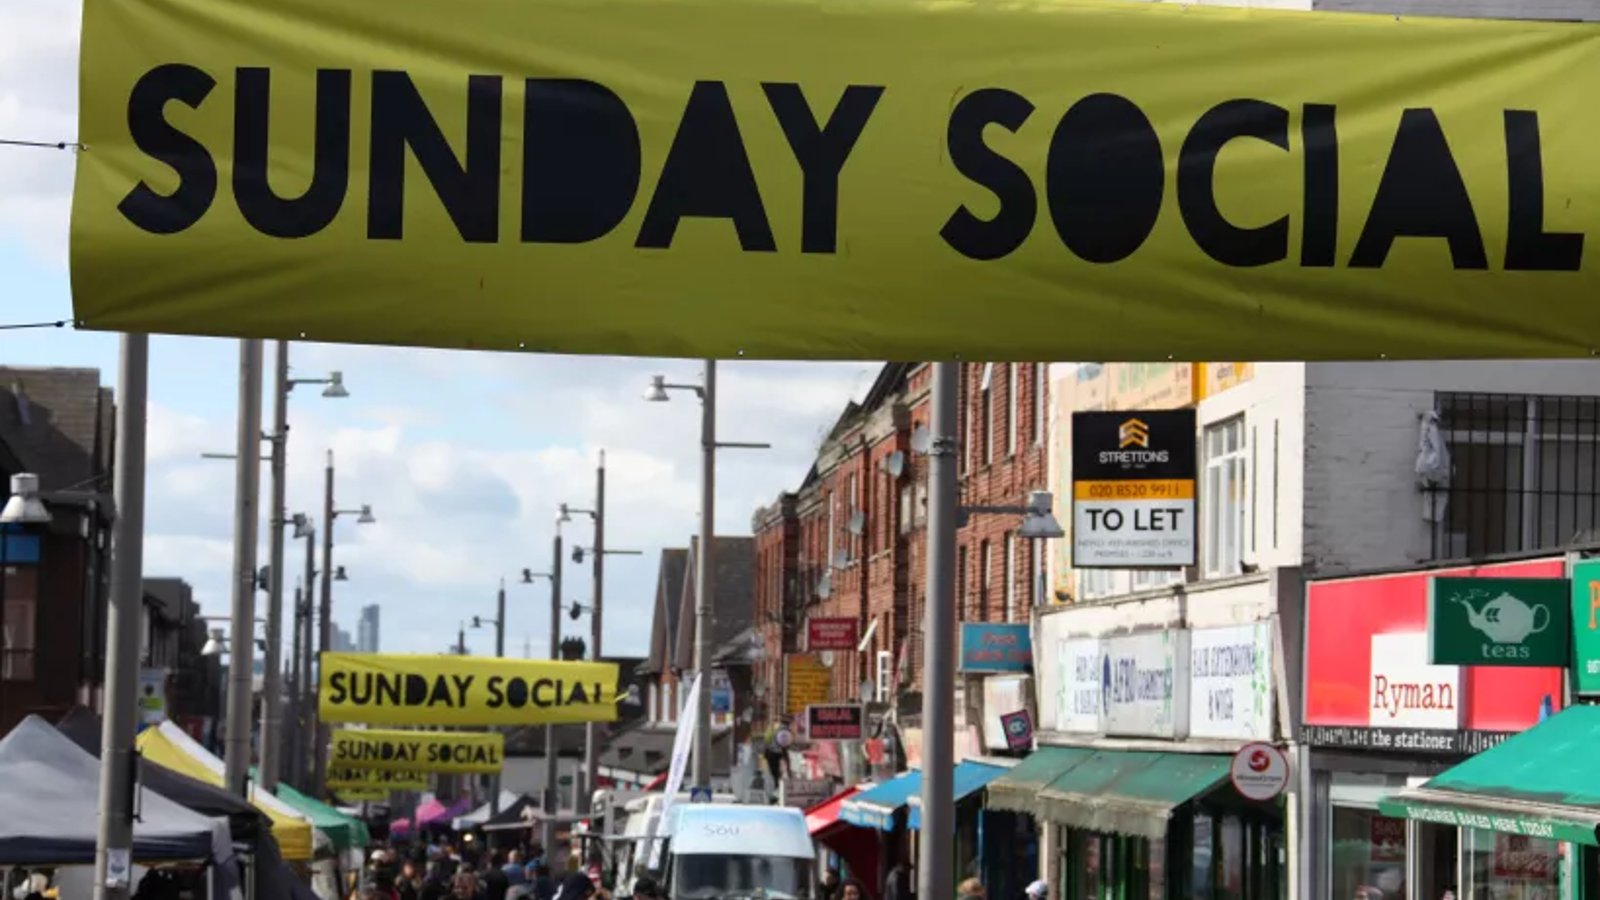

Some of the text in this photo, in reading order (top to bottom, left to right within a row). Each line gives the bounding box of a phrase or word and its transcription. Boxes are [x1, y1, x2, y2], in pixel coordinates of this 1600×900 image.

[117, 63, 1585, 271] SUNDAY SOCIAL
[1099, 450, 1169, 463] STRETTONS
[1089, 481, 1180, 498] 020 8520 9911
[1085, 507, 1184, 531] TO LET
[1482, 643, 1530, 658] teas
[329, 672, 474, 708] SUNDAY
[1373, 674, 1455, 717] Ryman
[337, 740, 498, 764] SUNDAY SOCIAL
[1372, 730, 1392, 747] the
[1394, 733, 1454, 751] stationer
[1457, 812, 1491, 829] BAKED
[1492, 817, 1520, 833] HERE
[1519, 821, 1554, 838] TODAY
